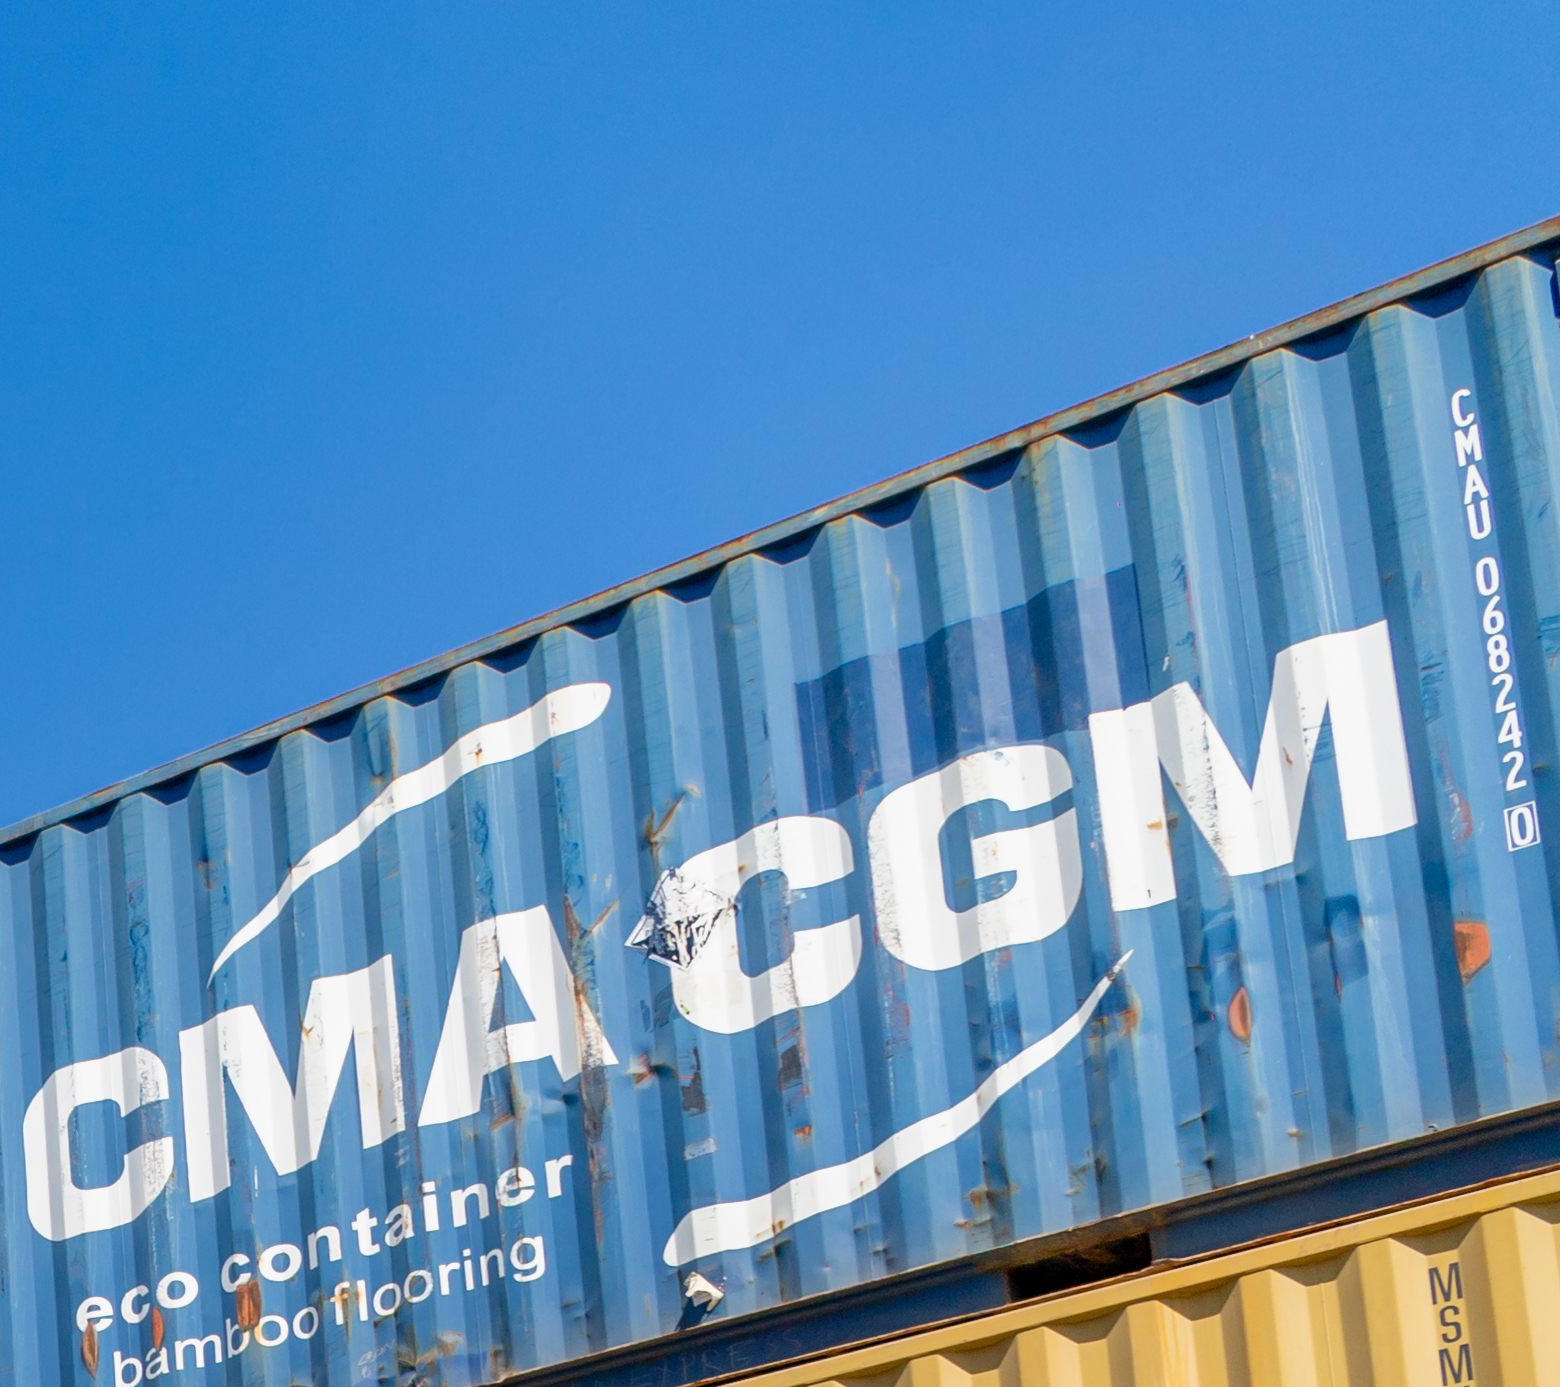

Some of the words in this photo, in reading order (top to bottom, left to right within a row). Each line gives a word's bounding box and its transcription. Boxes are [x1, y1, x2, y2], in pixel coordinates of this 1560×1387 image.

[1450, 388, 1493, 541] CMAU
[1475, 555, 1527, 793] 068242
[23, 903, 618, 1242] CMA
[670, 619, 1418, 1034] CGM
[75, 1270, 199, 1333] eco
[220, 1154, 573, 1294] container
[333, 1233, 547, 1325] flooring
